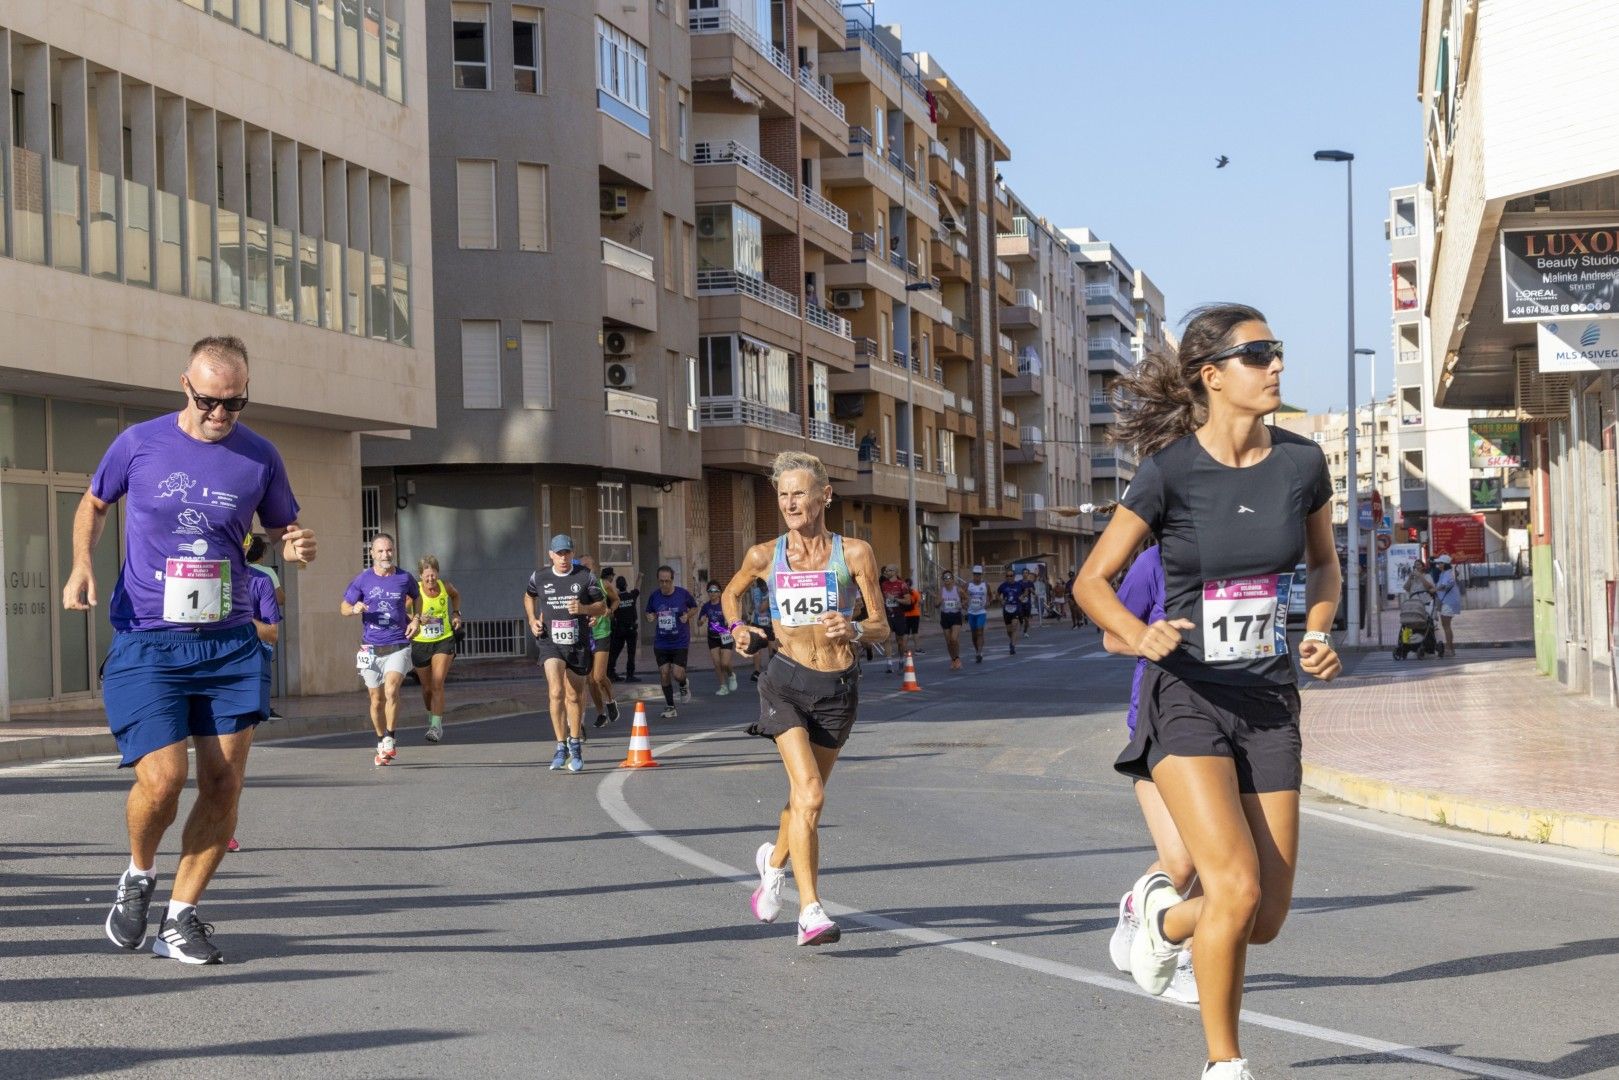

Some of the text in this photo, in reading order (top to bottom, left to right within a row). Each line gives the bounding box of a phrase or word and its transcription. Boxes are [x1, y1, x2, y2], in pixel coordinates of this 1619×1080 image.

[1537, 255, 1619, 269] Beauty Studio
[1542, 271, 1578, 283] Malinka
[1569, 283, 1595, 291] STYLIST
[1511, 306, 1525, 315] +34
[1526, 306, 1539, 314] 674
[1556, 349, 1618, 360] MLS ASIVEG
[222, 582, 231, 600] KM
[187, 590, 199, 609] 1
[781, 597, 823, 615] 145
[828, 591, 837, 607] KM
[1212, 614, 1272, 642] 177
[1275, 603, 1287, 641] 7 KM
[424, 627, 440, 635] 115
[554, 631, 573, 640] 103
